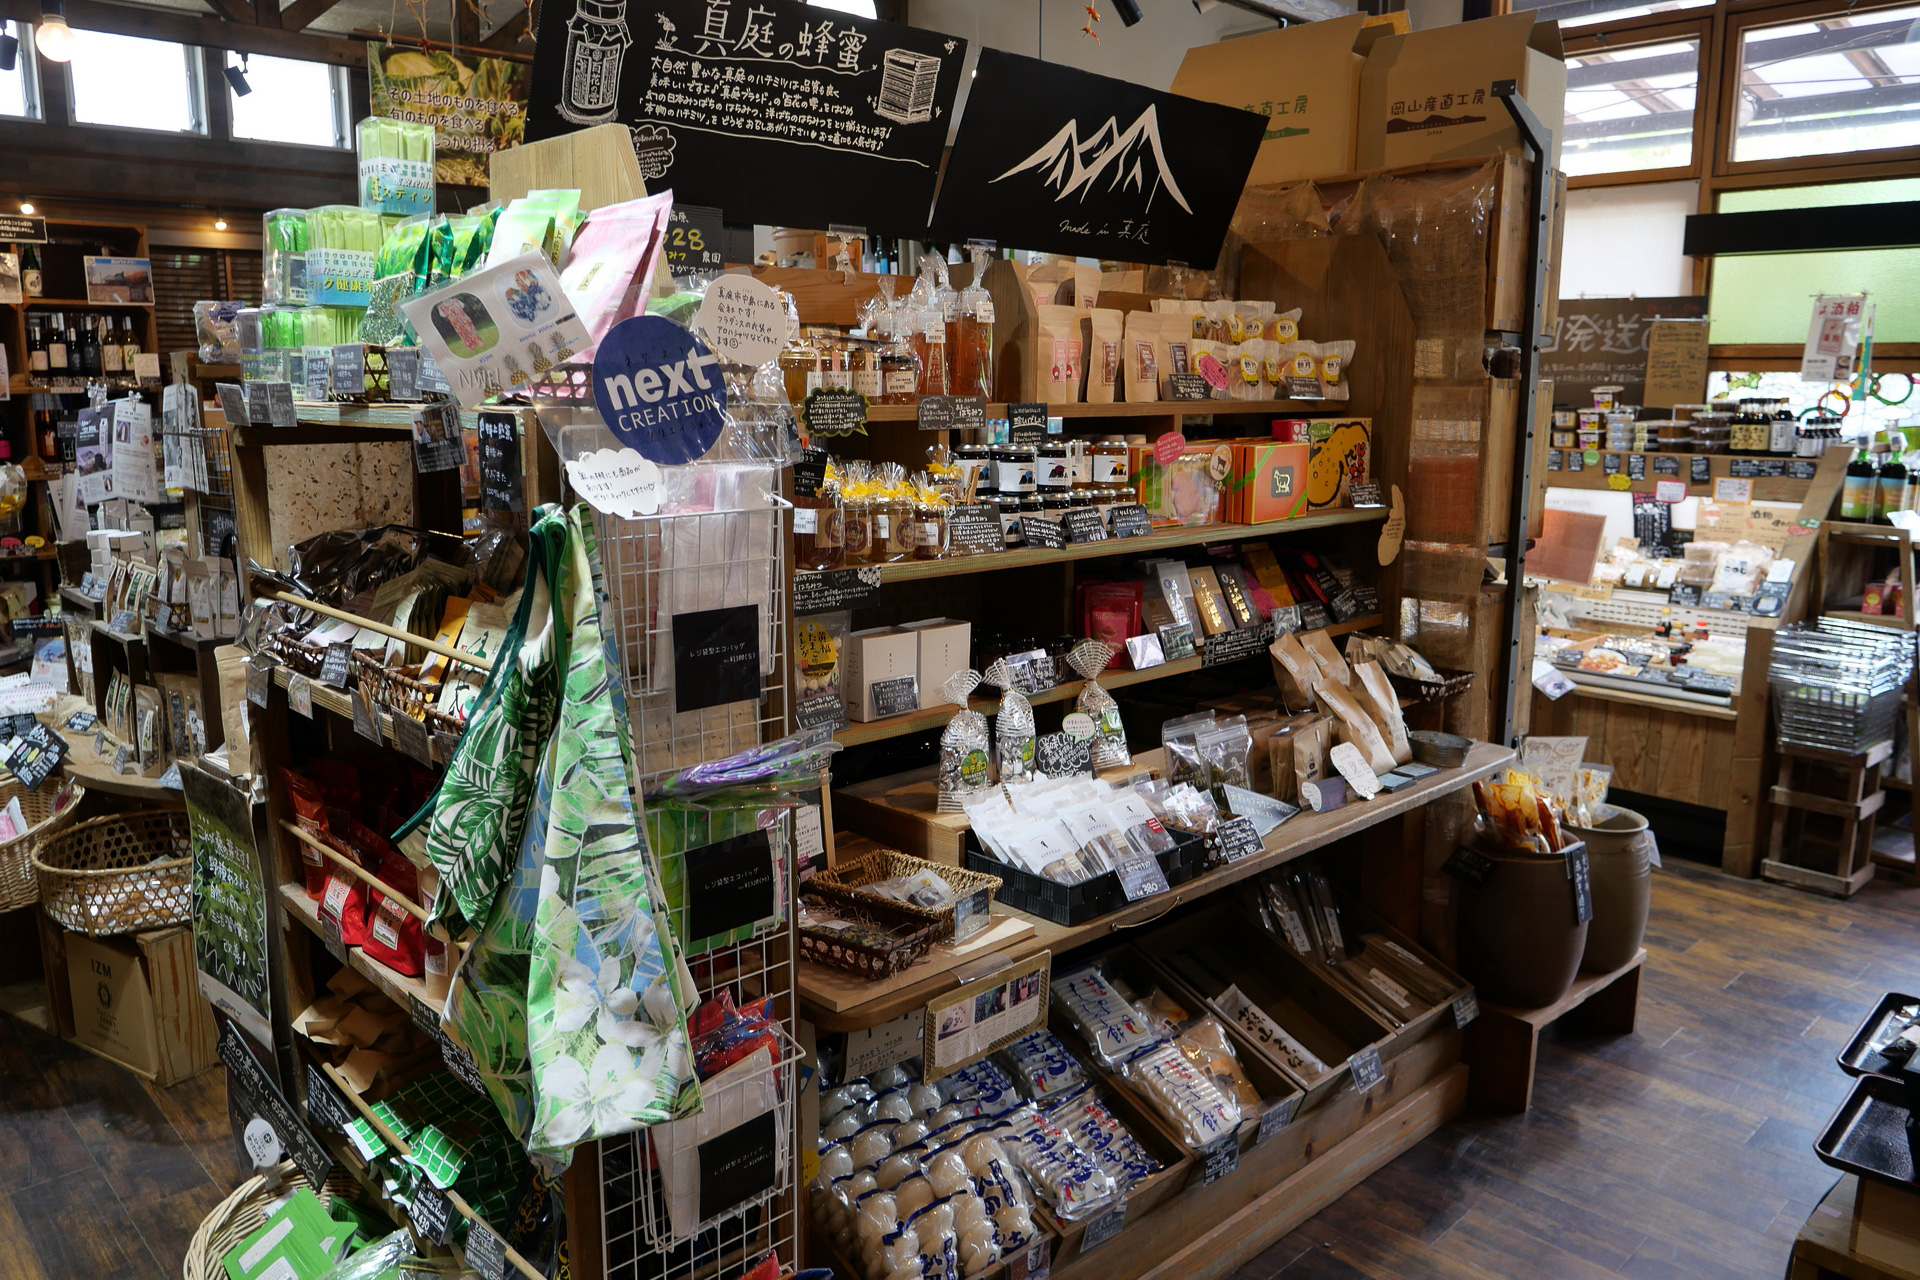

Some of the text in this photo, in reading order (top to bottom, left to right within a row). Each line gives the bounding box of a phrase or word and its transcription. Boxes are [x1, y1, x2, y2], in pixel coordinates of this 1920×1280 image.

[694, 0, 868, 73] 真庭の蜂蜜
[390, 88, 519, 116] その土地のものを食べる
[1390, 88, 1486, 116] 岡山産直工房
[390, 108, 485, 131] 旬のものを食べる
[1059, 220, 1091, 234] Made
[604, 345, 720, 412] next
[618, 392, 718, 432] CREATION
